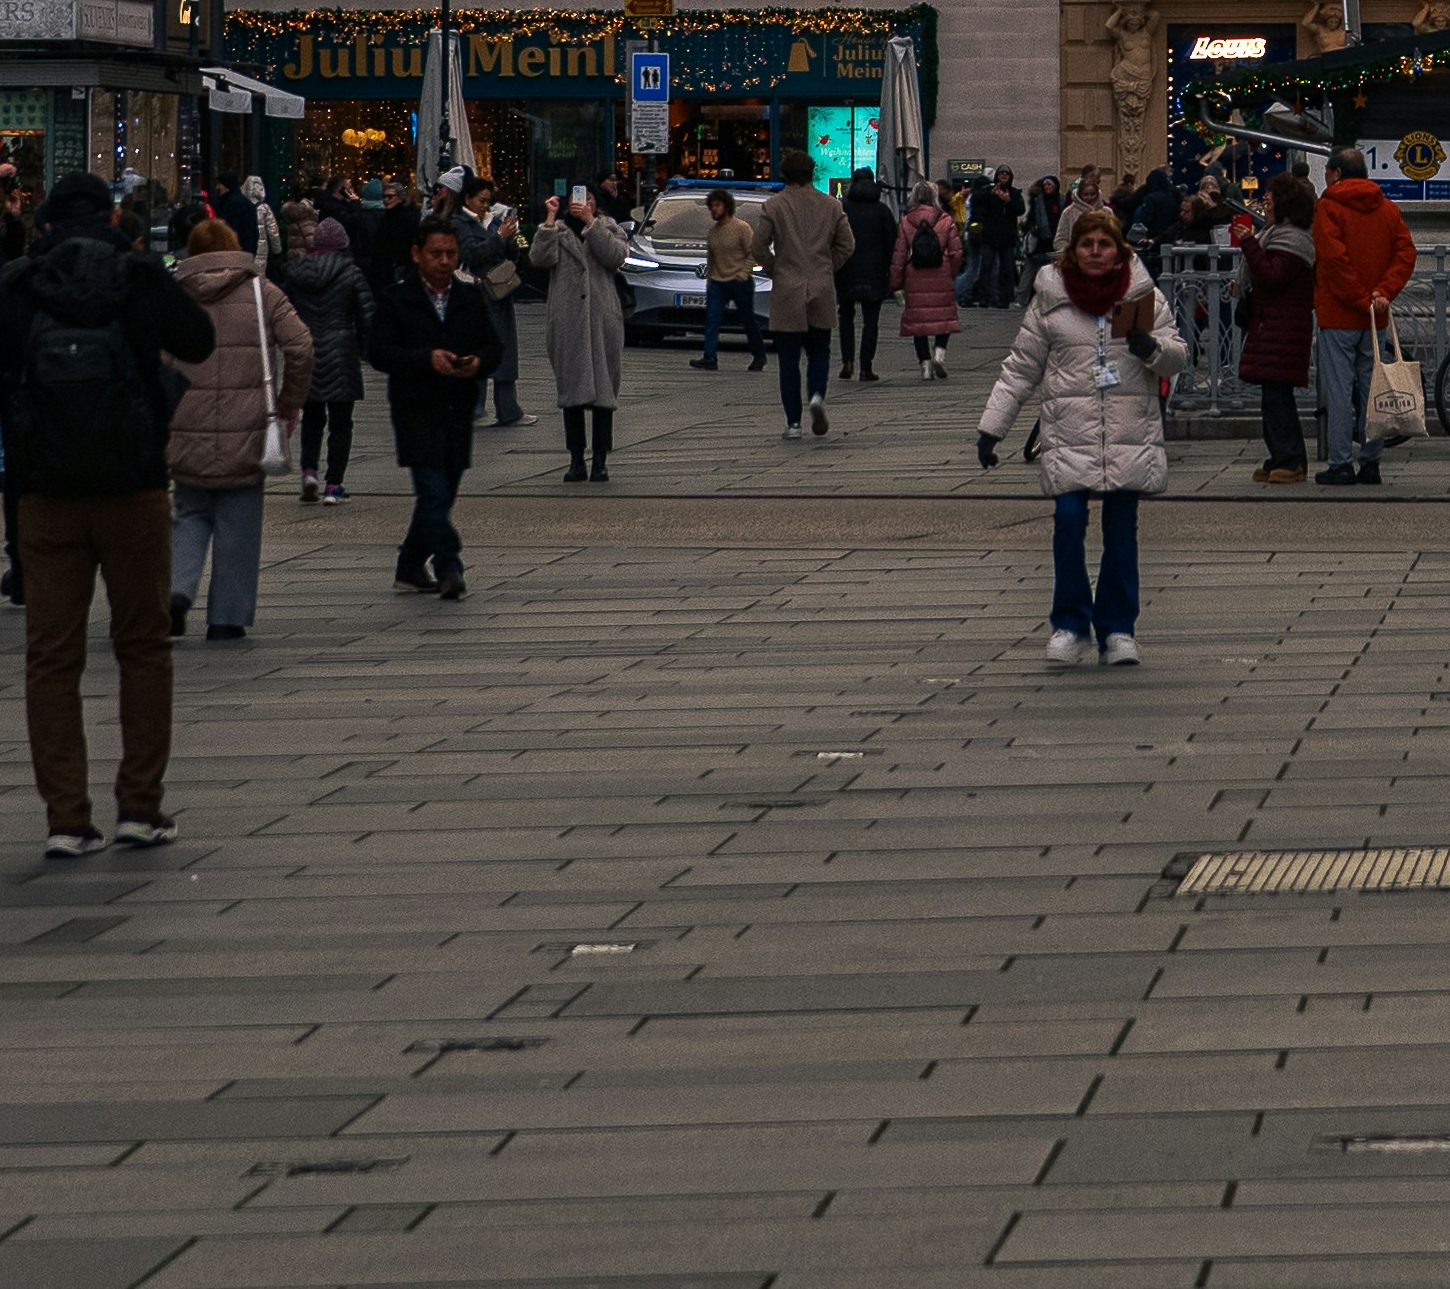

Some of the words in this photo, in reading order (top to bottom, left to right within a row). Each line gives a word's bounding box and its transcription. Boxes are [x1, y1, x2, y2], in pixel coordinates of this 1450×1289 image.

[283, 33, 424, 79] Juliu
[467, 33, 616, 77] Meinl
[836, 63, 883, 78] Mein
[1406, 130, 1437, 145] LIONS
[1366, 146, 1388, 170] 1.
[1415, 146, 1428, 164] L
[960, 162, 982, 170] CASH
